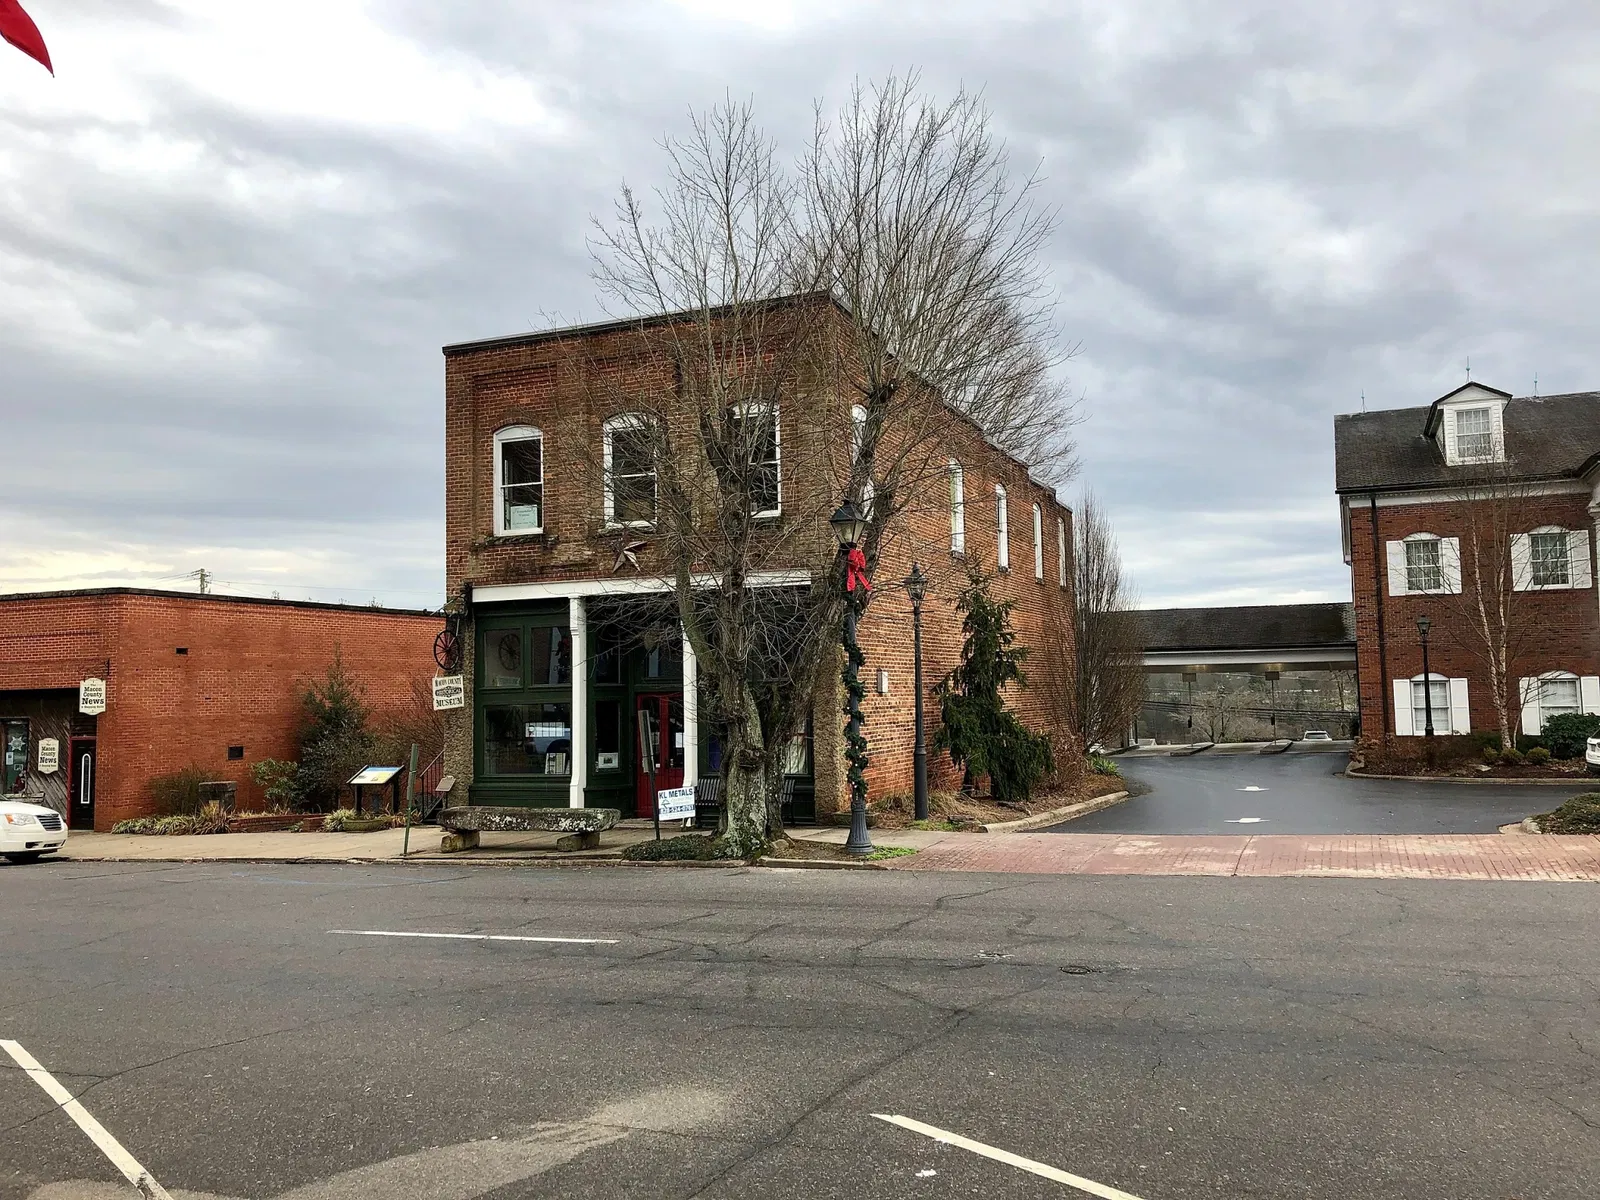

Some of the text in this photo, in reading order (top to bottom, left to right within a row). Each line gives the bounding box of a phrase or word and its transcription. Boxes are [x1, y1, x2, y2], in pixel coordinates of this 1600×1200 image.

[448, 676, 462, 685] COUNTY
[436, 696, 462, 707] MUSEUM
[659, 788, 693, 799] KL METALS
